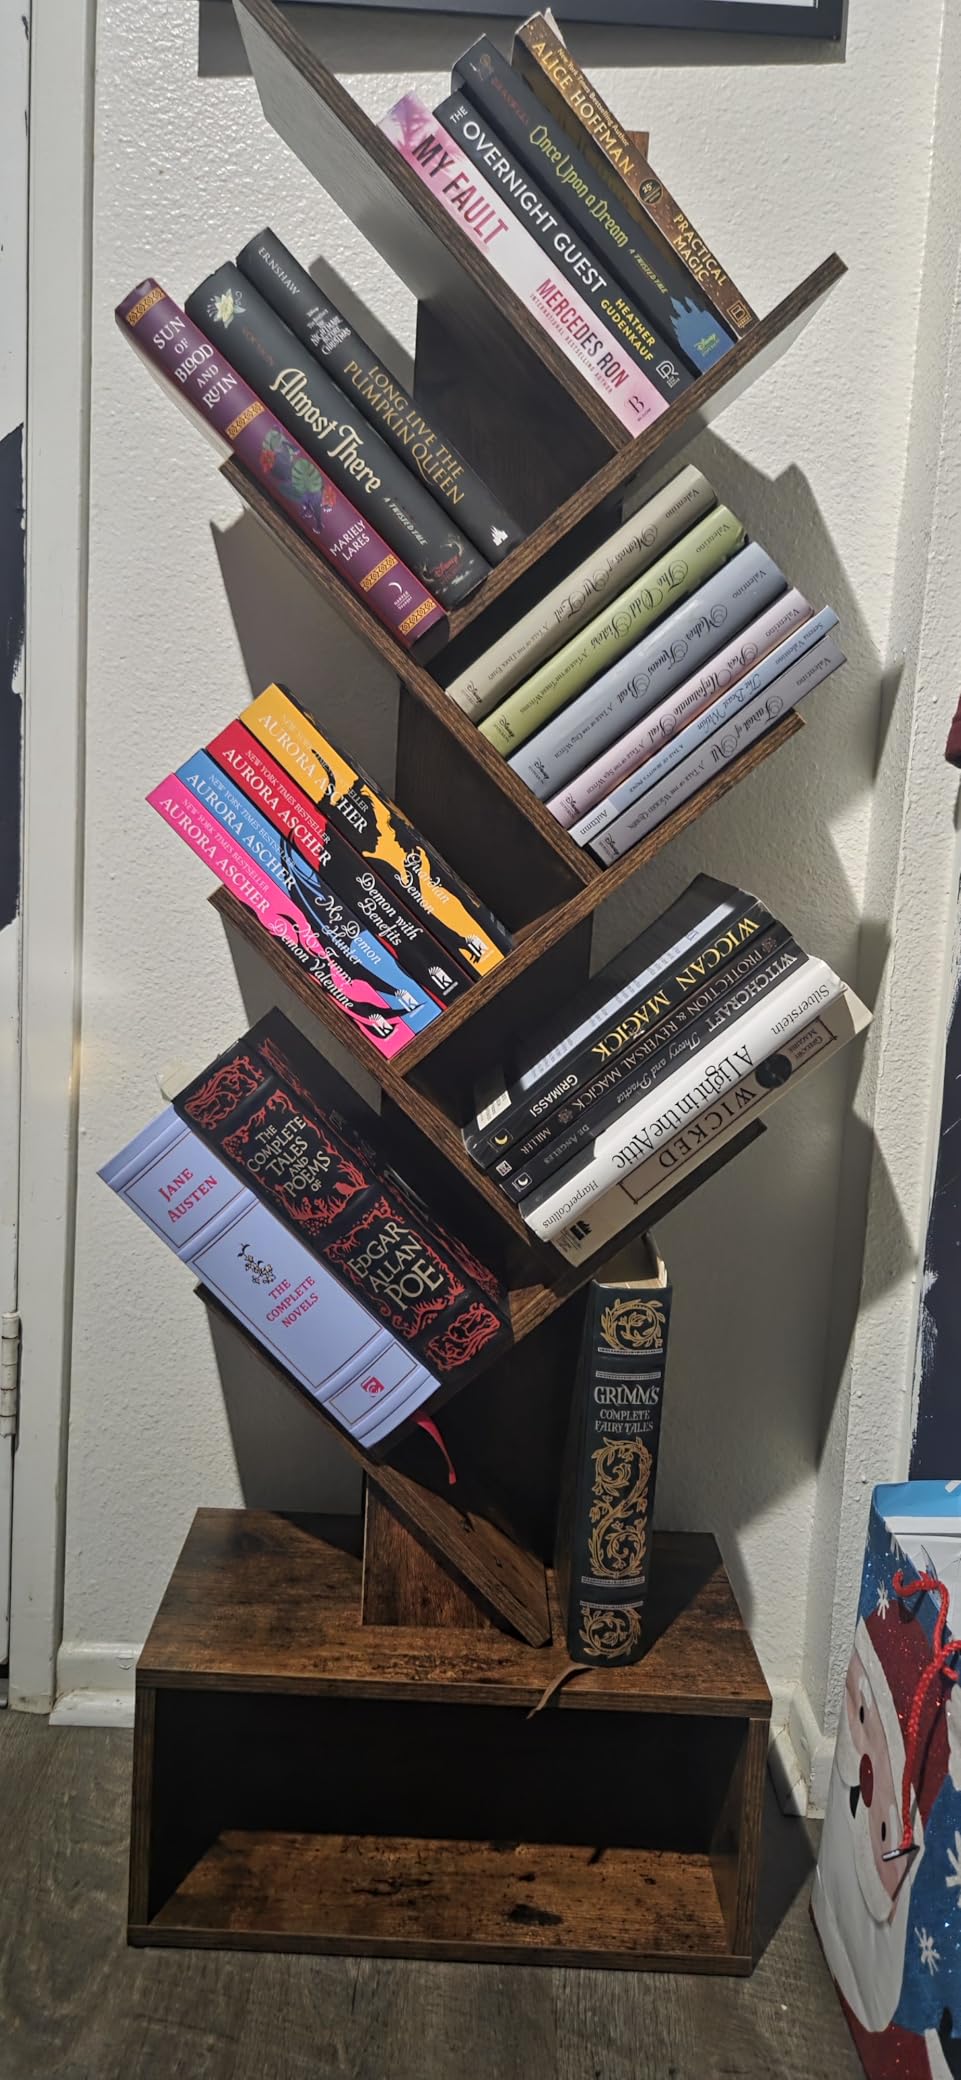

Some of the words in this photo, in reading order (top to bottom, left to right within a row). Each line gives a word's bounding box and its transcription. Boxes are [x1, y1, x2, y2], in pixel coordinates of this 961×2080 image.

[449, 106, 468, 123] THE
[532, 41, 572, 90] ALICE
[570, 90, 634, 173] HOFFMAN
[529, 124, 563, 164] Once
[612, 124, 629, 146] Author
[411, 135, 453, 177] MY
[441, 173, 508, 244] FAULT
[555, 155, 590, 198] Upon
[462, 121, 557, 232] OVERNIGHT
[553, 232, 606, 293] GUEST
[583, 192, 597, 208] a
[589, 199, 630, 248] Dream
[673, 214, 727, 286] PRACTICAL
[673, 235, 709, 281] MAGIC
[258, 247, 300, 295] ERNSHAW
[151, 316, 185, 349] SUN
[310, 315, 342, 345] NIGHTMARE
[321, 327, 352, 355] CHRISTMAS
[537, 279, 604, 356] MERCEDES
[597, 352, 629, 387] RON
[600, 299, 653, 361] GUDENKAUF
[615, 298, 655, 346] HEATHER
[172, 337, 189, 354] OF
[174, 343, 214, 382] BLOOD
[195, 364, 219, 387] AND
[201, 373, 237, 408] RUIN
[269, 365, 339, 441] Almost
[325, 423, 384, 495] There
[344, 360, 415, 444] PUMPKIN
[409, 442, 464, 506] QUEEN
[368, 366, 408, 411] LONG
[406, 410, 436, 446] LIVE
[435, 444, 464, 479] THE
[382, 495, 391, 503] A
[664, 488, 699, 519] Valentino
[329, 519, 366, 555] MARIELY
[342, 532, 370, 560] LARES
[611, 519, 659, 565] Mistress
[695, 523, 730, 554] Valentino
[582, 568, 613, 599] All
[654, 556, 691, 596] The
[732, 569, 766, 599] Valentino
[553, 592, 588, 626] Evil
[625, 580, 666, 623] Odd
[589, 608, 633, 652] Sisters
[682, 601, 731, 648] Mother
[764, 608, 800, 637] Valentino
[803, 622, 823, 640] Serena
[646, 638, 690, 677] Knows
[724, 639, 762, 675] Poor
[775, 640, 804, 665] Valentino
[796, 657, 831, 687] Valentino
[466, 683, 487, 704] Disney
[613, 669, 654, 710] Best
[669, 661, 734, 722] Unfortunate
[722, 687, 746, 710] Beast
[743, 672, 762, 694] The
[496, 713, 516, 738] Disney
[643, 710, 681, 746] Soul
[697, 708, 726, 734] Within
[731, 722, 745, 739] of
[739, 691, 786, 737] Fairest
[707, 732, 741, 766] All
[259, 714, 316, 775] AURORA
[314, 774, 369, 832] ASCHER
[531, 757, 553, 782] Disney
[208, 774, 225, 791] NEW
[223, 790, 241, 810] YORK
[240, 808, 260, 830] TIMES
[222, 748, 280, 809] AURORA
[278, 809, 333, 867] ASCHER
[245, 750, 262, 767] NEW
[260, 766, 278, 786] YORK
[277, 784, 296, 805] TIMES
[294, 803, 331, 844] BESTSELLER
[187, 773, 244, 834] AURORA
[242, 834, 298, 891] ASCHER
[580, 809, 608, 835] Autumn
[160, 798, 218, 858] AURORA
[216, 858, 270, 913] ASCHER
[182, 798, 198, 815] NEW
[197, 814, 214, 833] YORK
[213, 832, 234, 853] TIMES
[232, 852, 269, 891] BESTSELLER
[602, 832, 622, 857] Disney
[394, 866, 439, 914] Demon
[402, 849, 451, 899] Guardian
[355, 871, 398, 917] Demon
[395, 914, 423, 940] with
[356, 896, 403, 950] Benefits
[314, 892, 344, 922] My
[339, 917, 382, 964] Demon
[321, 920, 367, 965] Hunter
[269, 920, 314, 963] Demon
[306, 957, 356, 1009] Valentine
[291, 920, 324, 952] My
[316, 945, 355, 988] Funny
[675, 917, 759, 990] WICCAN
[686, 949, 762, 1015] PROTECTION
[705, 952, 797, 1031] WITCHCRAFT
[592, 990, 670, 1061] MAGICK
[674, 1010, 687, 1022] &
[771, 984, 830, 1036] Silverstein
[621, 1021, 678, 1069] REVERSAL
[664, 1026, 703, 1064] Theory
[731, 1043, 758, 1071] A
[650, 1058, 667, 1078] and
[692, 1056, 741, 1104] Light
[529, 1073, 578, 1117] GRIMASSI
[572, 1067, 622, 1110] MAGICK
[616, 1072, 652, 1105] Practice
[675, 1093, 700, 1116] in
[247, 1115, 307, 1173] COMPLETE
[255, 1124, 278, 1144] THE
[520, 1127, 551, 1155] MILLER
[651, 1109, 682, 1139] the
[657, 1086, 756, 1168] WICKED
[265, 1136, 308, 1176] TALES
[288, 1157, 309, 1177] AND
[611, 1127, 656, 1174] Attic
[158, 1168, 194, 1202] JANE
[283, 1151, 331, 1198] POEMS
[311, 1180, 323, 1192] OF
[167, 1175, 218, 1223] AUSTEN
[542, 1180, 598, 1228] HarperCollins
[347, 1221, 410, 1279] EDGAR
[369, 1235, 423, 1293] ALLAN
[266, 1275, 315, 1322] COMPLETE
[268, 1279, 291, 1300] THE
[384, 1258, 444, 1311] POE
[282, 1292, 319, 1328] NOVELS
[594, 1384, 660, 1407] GRIMM'S
[599, 1408, 651, 1421] COMPLETE
[594, 1420, 624, 1433] FAIRY
[624, 1421, 653, 1435] TALES
